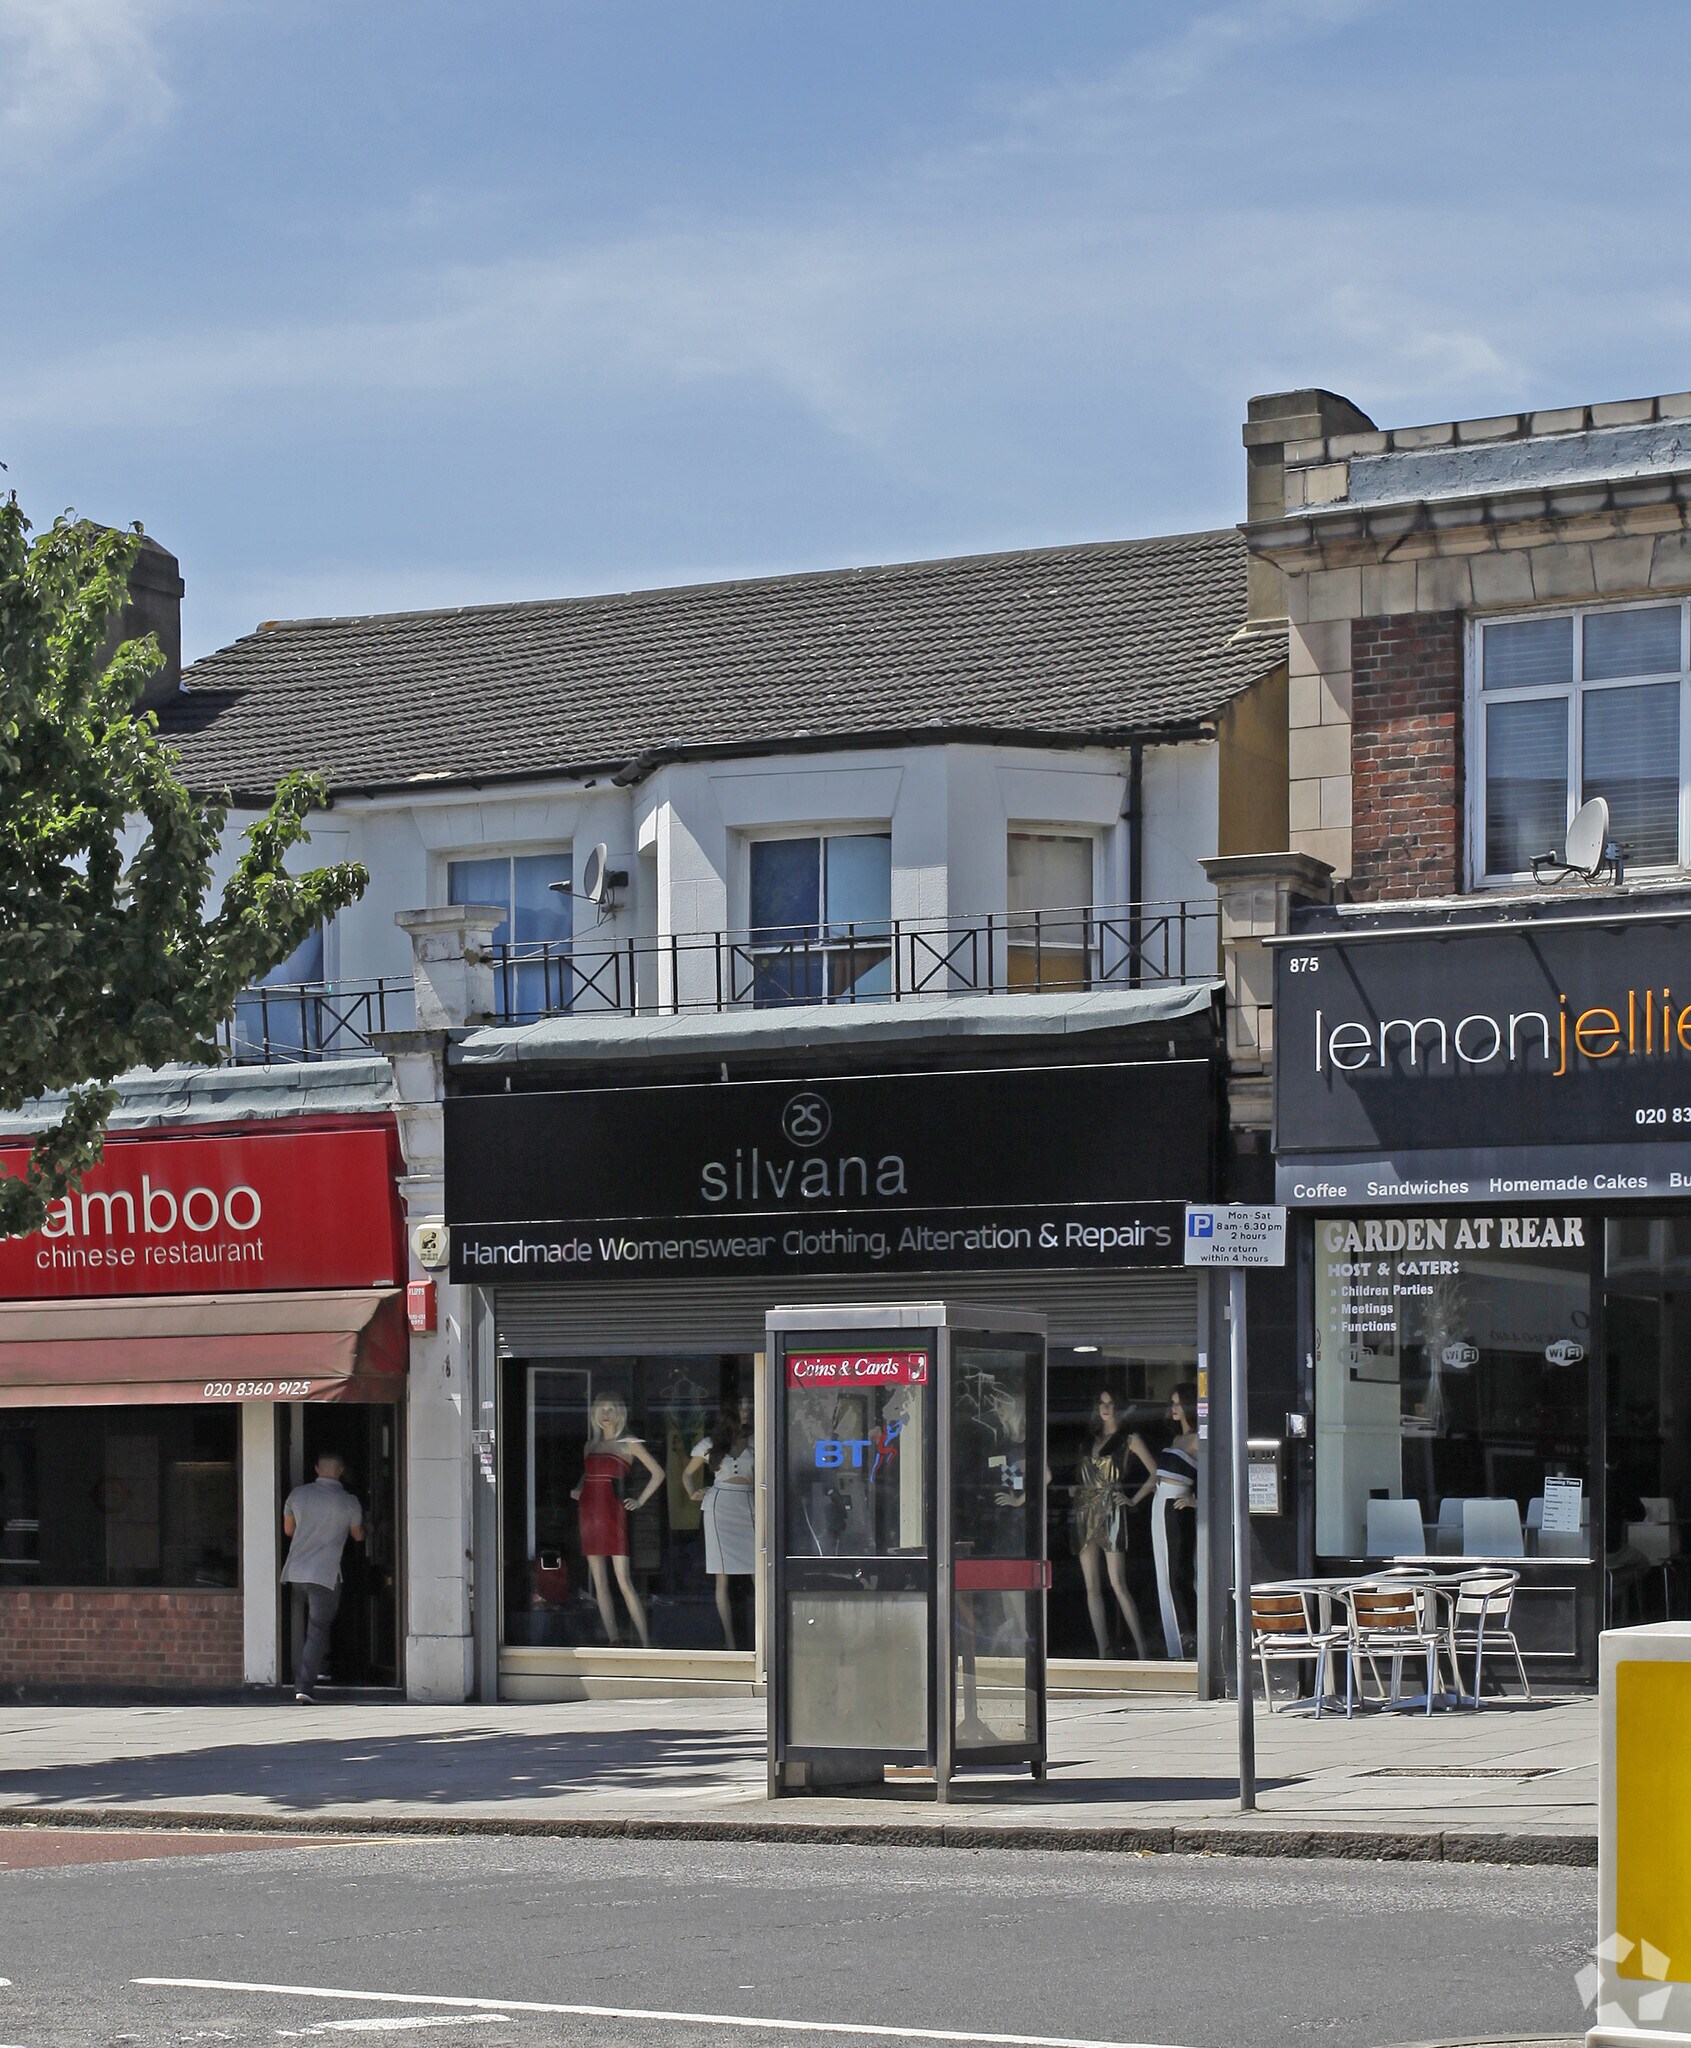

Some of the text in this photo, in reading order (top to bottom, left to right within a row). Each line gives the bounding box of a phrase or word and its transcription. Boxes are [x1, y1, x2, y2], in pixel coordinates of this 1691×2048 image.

[1289, 957, 1319, 973] 875
[1636, 1109, 1667, 1124] 020
[701, 1148, 907, 1200] silvana
[1293, 1183, 1347, 1198] Coffee
[1367, 1179, 1469, 1197] Sandwiches
[1489, 1175, 1588, 1193] Homemade
[1594, 1174, 1648, 1190] Cakes
[0, 1174, 262, 1241] amboo
[1228, 1212, 1248, 1220] Mon
[1255, 1211, 1271, 1220] Sat
[463, 1220, 1172, 1265] Handmade Womenswear Clothing, Alteration & Repairs
[1230, 1231, 1267, 1240] 2 hours
[1324, 1217, 1585, 1253] GARDEN AT REAR
[37, 1237, 264, 1269] chinese restaurant
[1212, 1245, 1258, 1253] No return
[1200, 1254, 1269, 1263] within 4 hours
[1327, 1261, 1460, 1277] HOST & CATER:
[1341, 1284, 1434, 1296] Children Parties
[1341, 1303, 1394, 1316] Meetings
[1341, 1321, 1397, 1332] Functions
[794, 1358, 899, 1377] Coins & Cards
[204, 1381, 311, 1397] 020 8360 9125
[815, 1440, 872, 1468] BT
